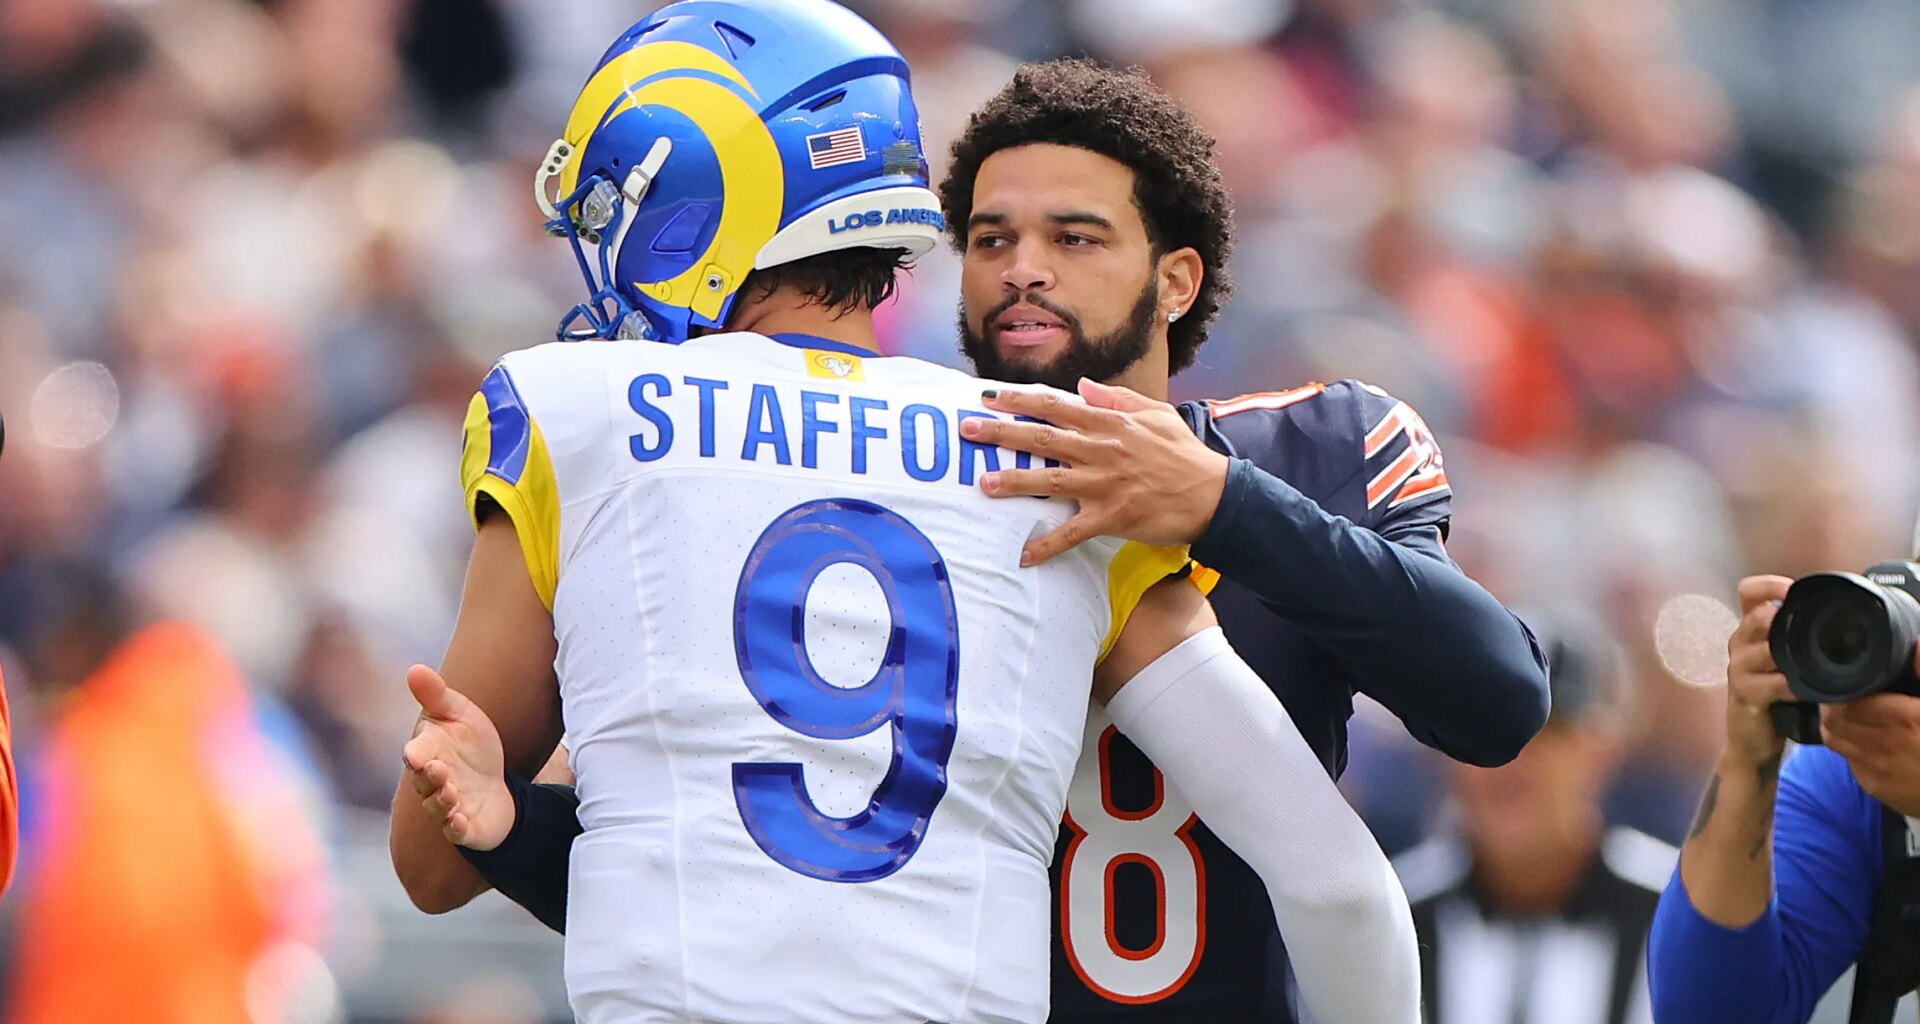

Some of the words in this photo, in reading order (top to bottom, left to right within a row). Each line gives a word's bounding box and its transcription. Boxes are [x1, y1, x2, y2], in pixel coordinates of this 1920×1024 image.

[828, 210, 883, 235] LOS
[1868, 572, 1906, 585] Canon
[732, 497, 960, 883] 9
